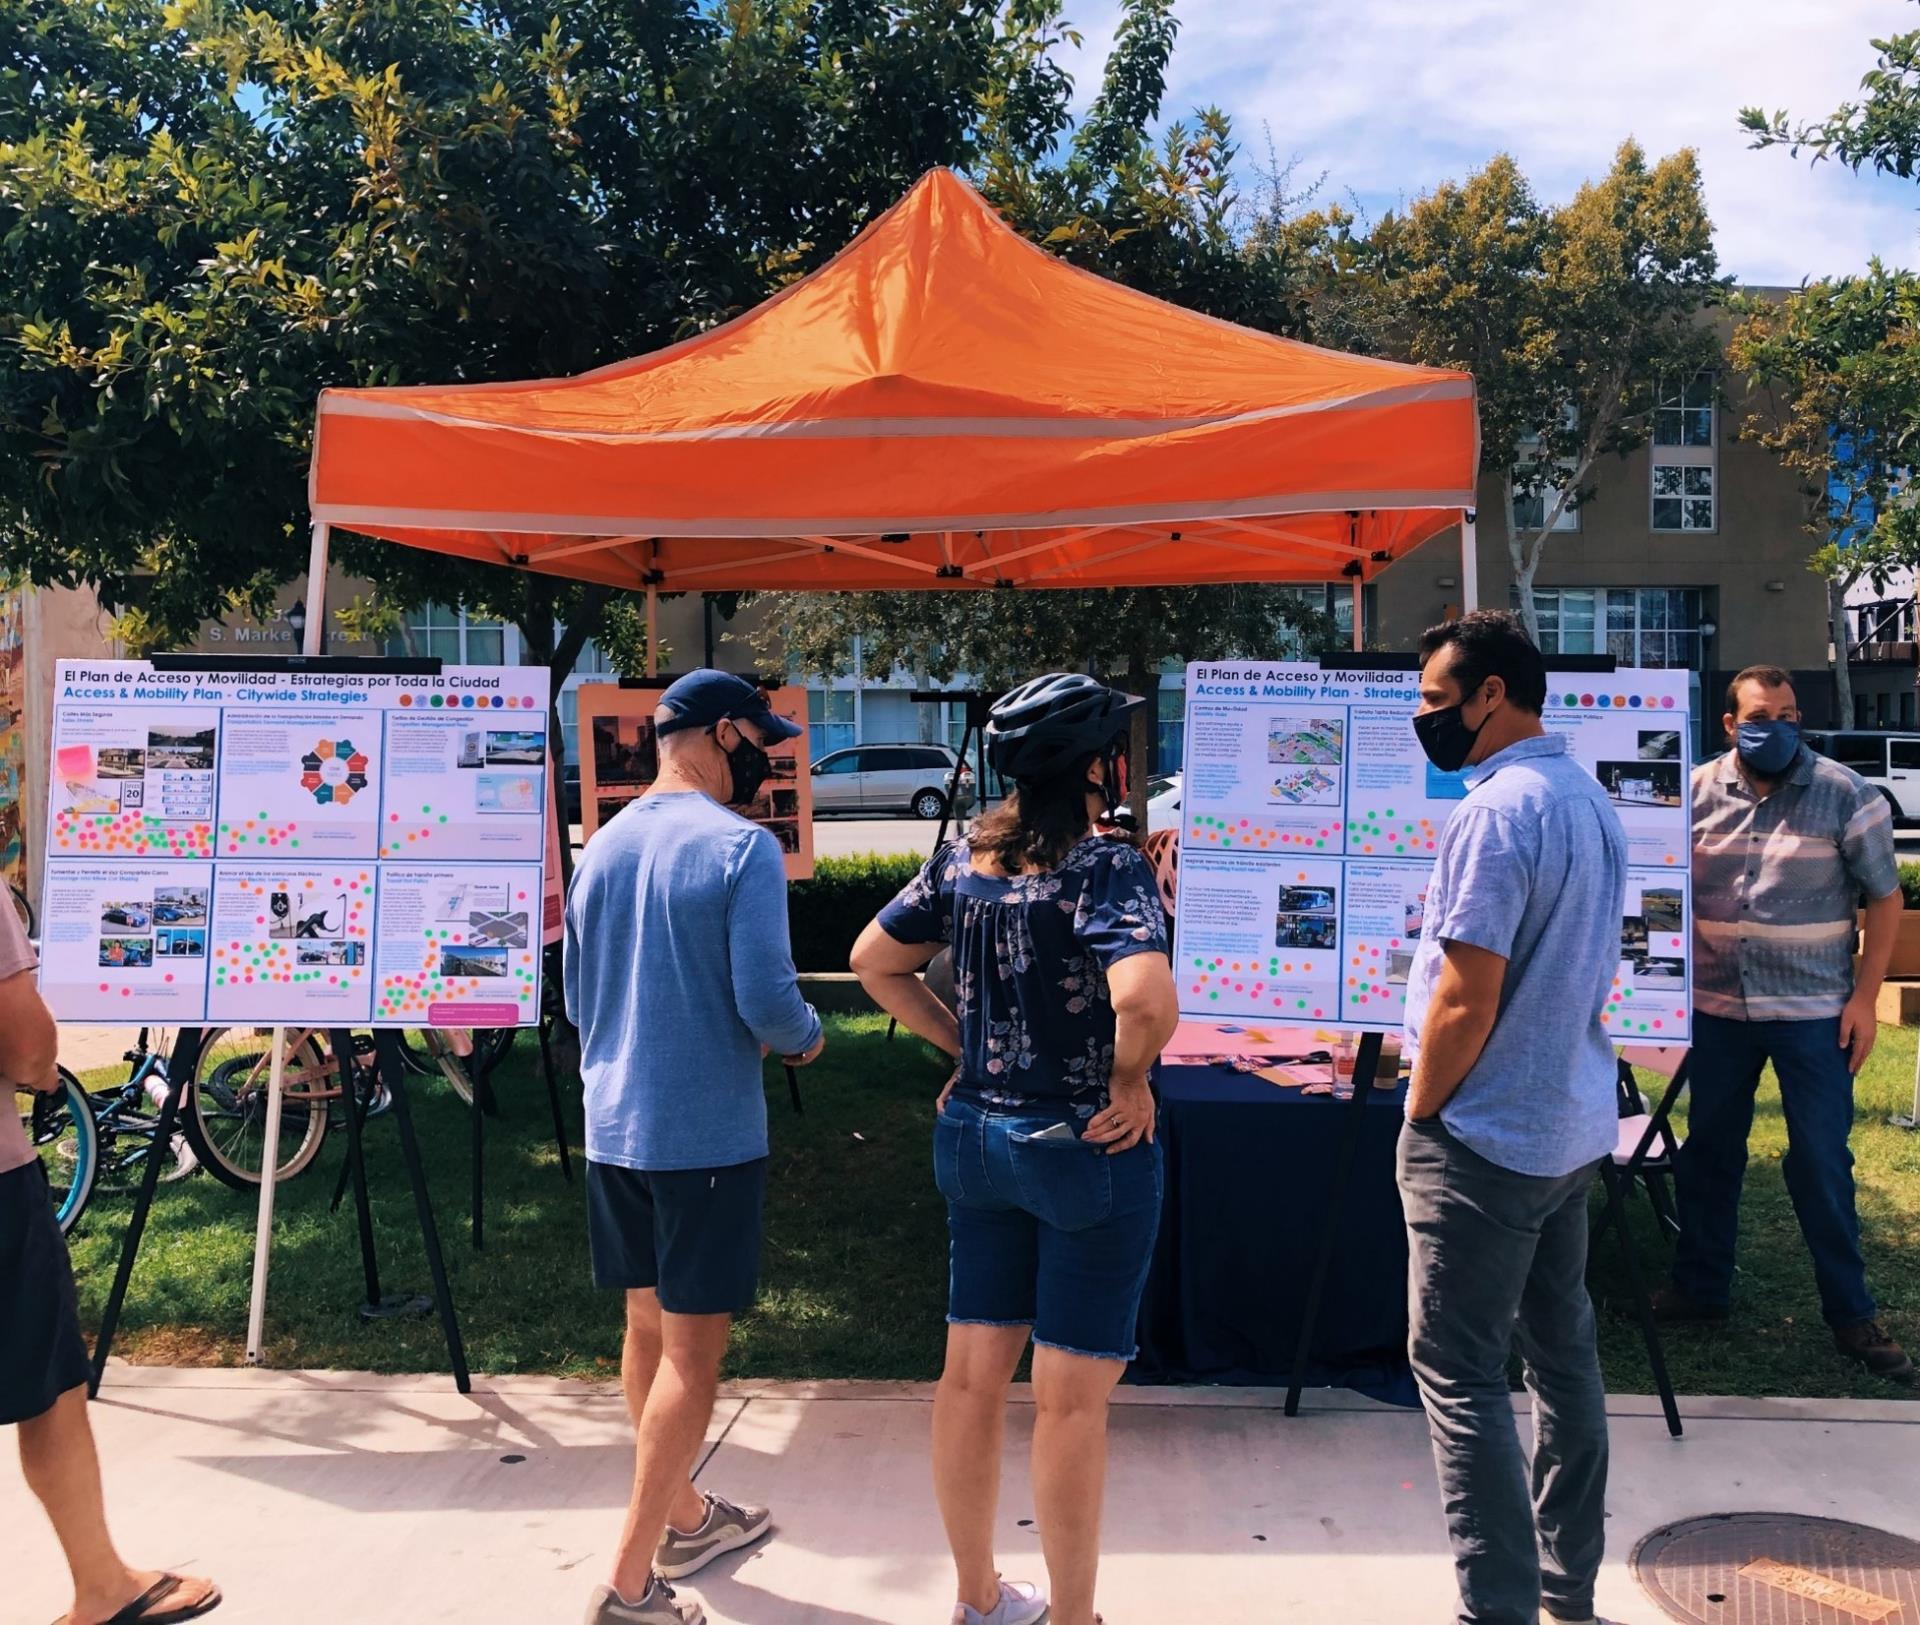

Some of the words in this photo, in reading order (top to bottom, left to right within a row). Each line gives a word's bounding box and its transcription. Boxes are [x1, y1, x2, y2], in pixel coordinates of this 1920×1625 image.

[209, 628, 226, 641] S.
[235, 627, 291, 642] Marke
[64, 670, 75, 681] El
[79, 670, 109, 682] Plan
[113, 671, 132, 682] de
[137, 672, 191, 683] Acceso
[196, 674, 204, 686] y
[208, 672, 276, 685] Movilidad
[290, 673, 364, 688] Estrategias
[368, 676, 391, 688] por
[395, 675, 428, 688] Toda
[433, 676, 445, 688] la
[449, 676, 500, 688] Ciudad
[1196, 669, 1207, 679] El
[1211, 669, 1239, 680] Plan
[1243, 669, 1261, 680] de
[1265, 670, 1318, 681] Acceso
[1322, 673, 1331, 684] y
[1334, 671, 1404, 683] Movilidad
[63, 687, 115, 698] Access
[119, 687, 128, 698] &
[133, 687, 189, 702] Mobility
[192, 688, 222, 700] Plan
[235, 688, 297, 703] Citywide
[300, 689, 368, 704] Strategies
[1195, 684, 1245, 695] Access
[1248, 685, 1258, 696] &
[1262, 685, 1316, 699] Mobility
[1320, 686, 1349, 698] Plan
[126, 789, 140, 798] 20
